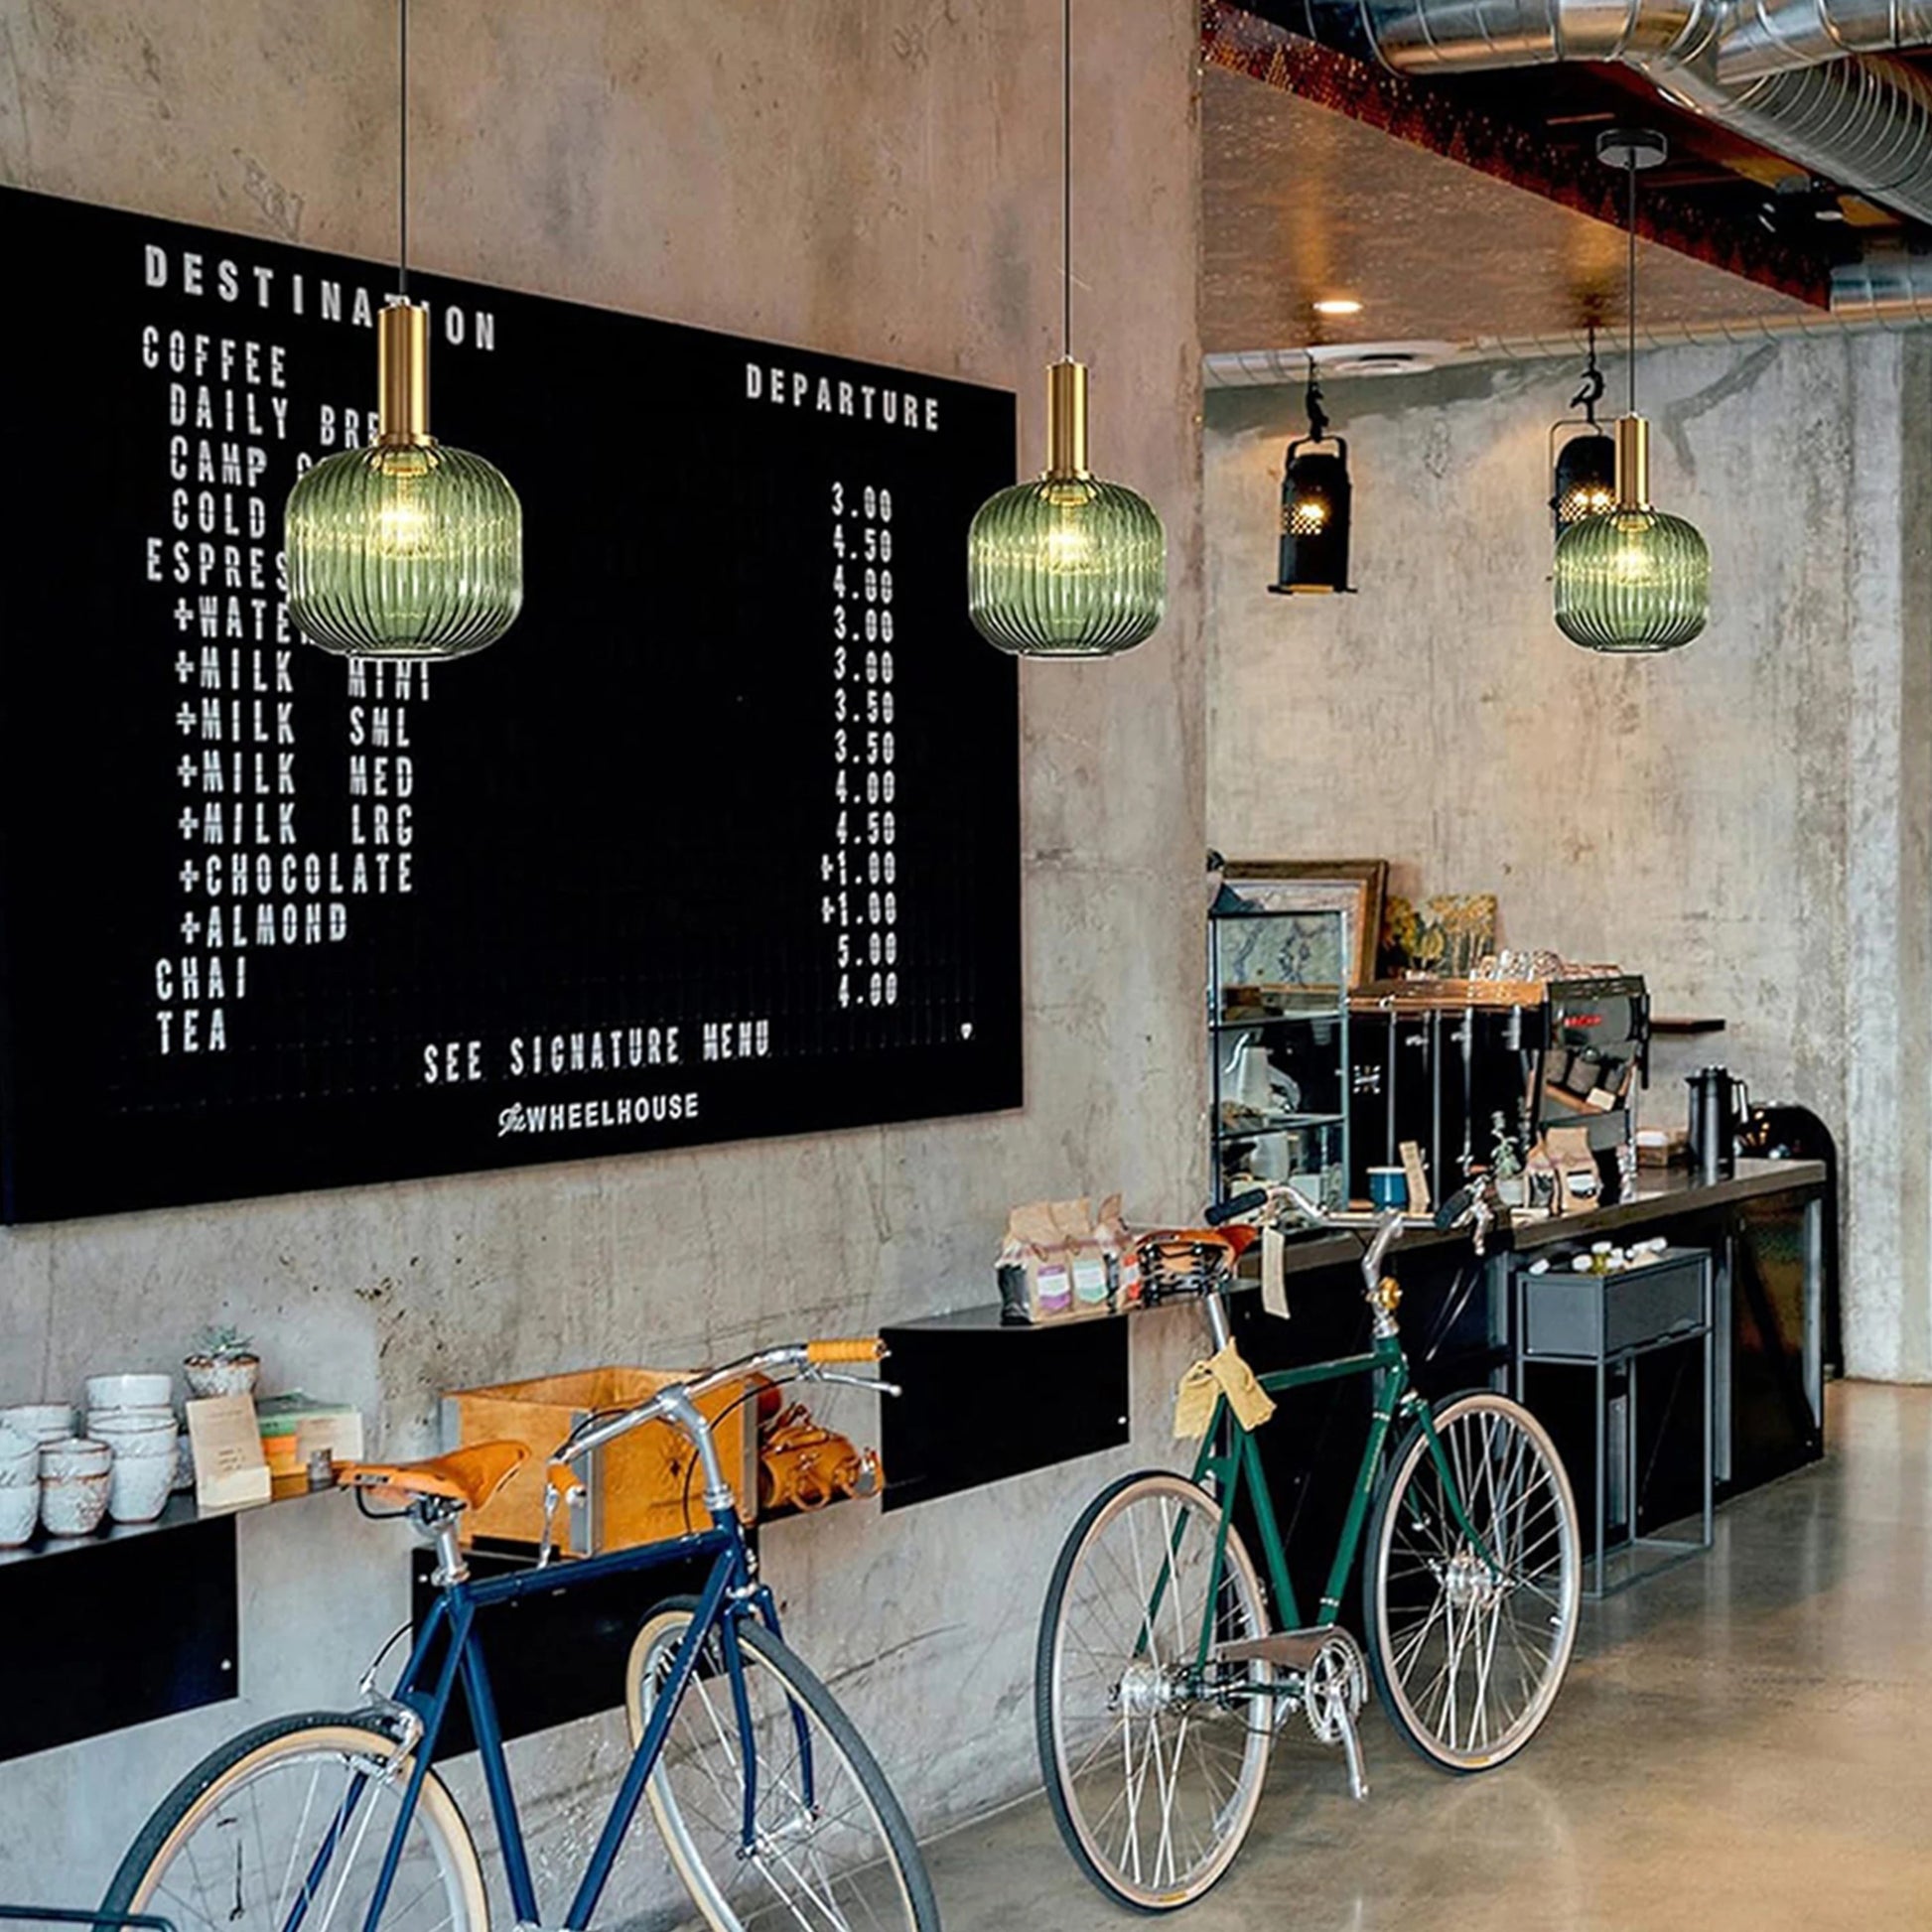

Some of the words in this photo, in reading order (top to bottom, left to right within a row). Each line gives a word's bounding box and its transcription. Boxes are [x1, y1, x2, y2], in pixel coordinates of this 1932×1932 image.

[145, 244, 494, 351] DESTINAON
[142, 325, 286, 389] COFFEE
[170, 382, 288, 440] DAILY
[320, 404, 380, 451] BRE
[746, 362, 938, 432] DEPARTURE
[170, 435, 267, 488] CAMP
[172, 487, 266, 539] COLD
[831, 482, 893, 523] 3.00
[147, 537, 289, 592] ESPRES
[833, 523, 892, 563] 4.50
[833, 564, 894, 605] 4.00
[174, 595, 317, 645] +WATE
[833, 605, 894, 643] 3.00
[175, 645, 294, 693] +MILK
[348, 657, 429, 701] MINI
[833, 645, 894, 684] 3.00
[176, 697, 295, 745] +MILK
[348, 705, 410, 748] SML
[834, 687, 895, 725] 3.50
[834, 728, 895, 765] 3.50
[177, 749, 296, 795] +MILK
[349, 755, 413, 798] MED
[835, 768, 896, 805] 4.00
[178, 801, 297, 845] +MILK
[351, 803, 413, 847] LRG
[836, 810, 896, 846] 4.50
[179, 852, 412, 897] +CHOCOLATE
[820, 849, 896, 887] +1.00
[180, 902, 347, 948] +ALMOND
[821, 891, 897, 927] +1.00
[837, 931, 897, 969] 5.00
[155, 955, 246, 1001] CHAI
[838, 971, 897, 1009] 4.00
[156, 1008, 226, 1055] TEA
[423, 1040, 482, 1084] SEE
[509, 1026, 679, 1076] SIGNATURE
[703, 1019, 769, 1061] MENU
[525, 1092, 699, 1134] WHEELHOUSE
